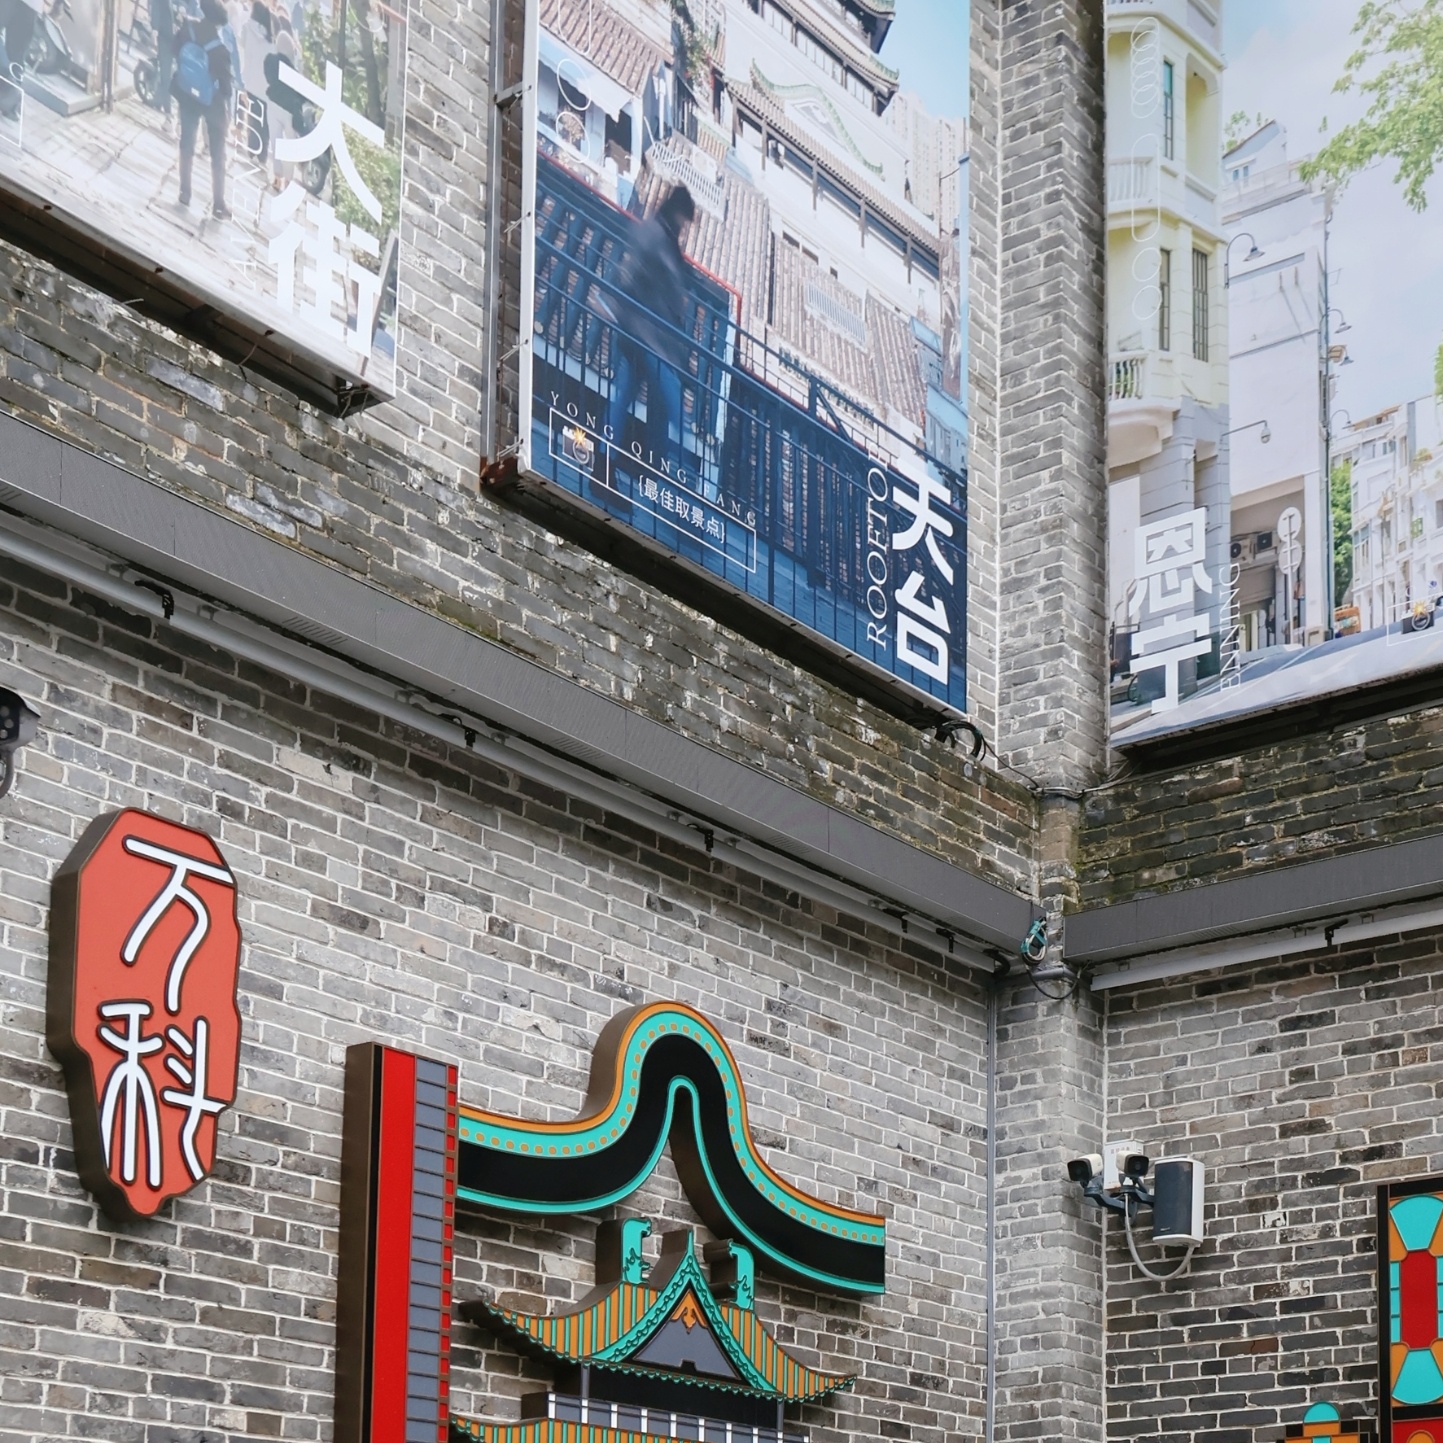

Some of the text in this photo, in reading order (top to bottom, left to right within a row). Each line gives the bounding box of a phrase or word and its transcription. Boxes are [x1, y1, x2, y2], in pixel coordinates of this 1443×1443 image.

[271, 58, 386, 359] 大街
[551, 391, 756, 526] YONG QING FANG
[892, 457, 954, 686] 天台
[1129, 507, 1212, 715] 恩宁
[1219, 562, 1241, 692] ENNING
[99, 834, 235, 1190] 万科
